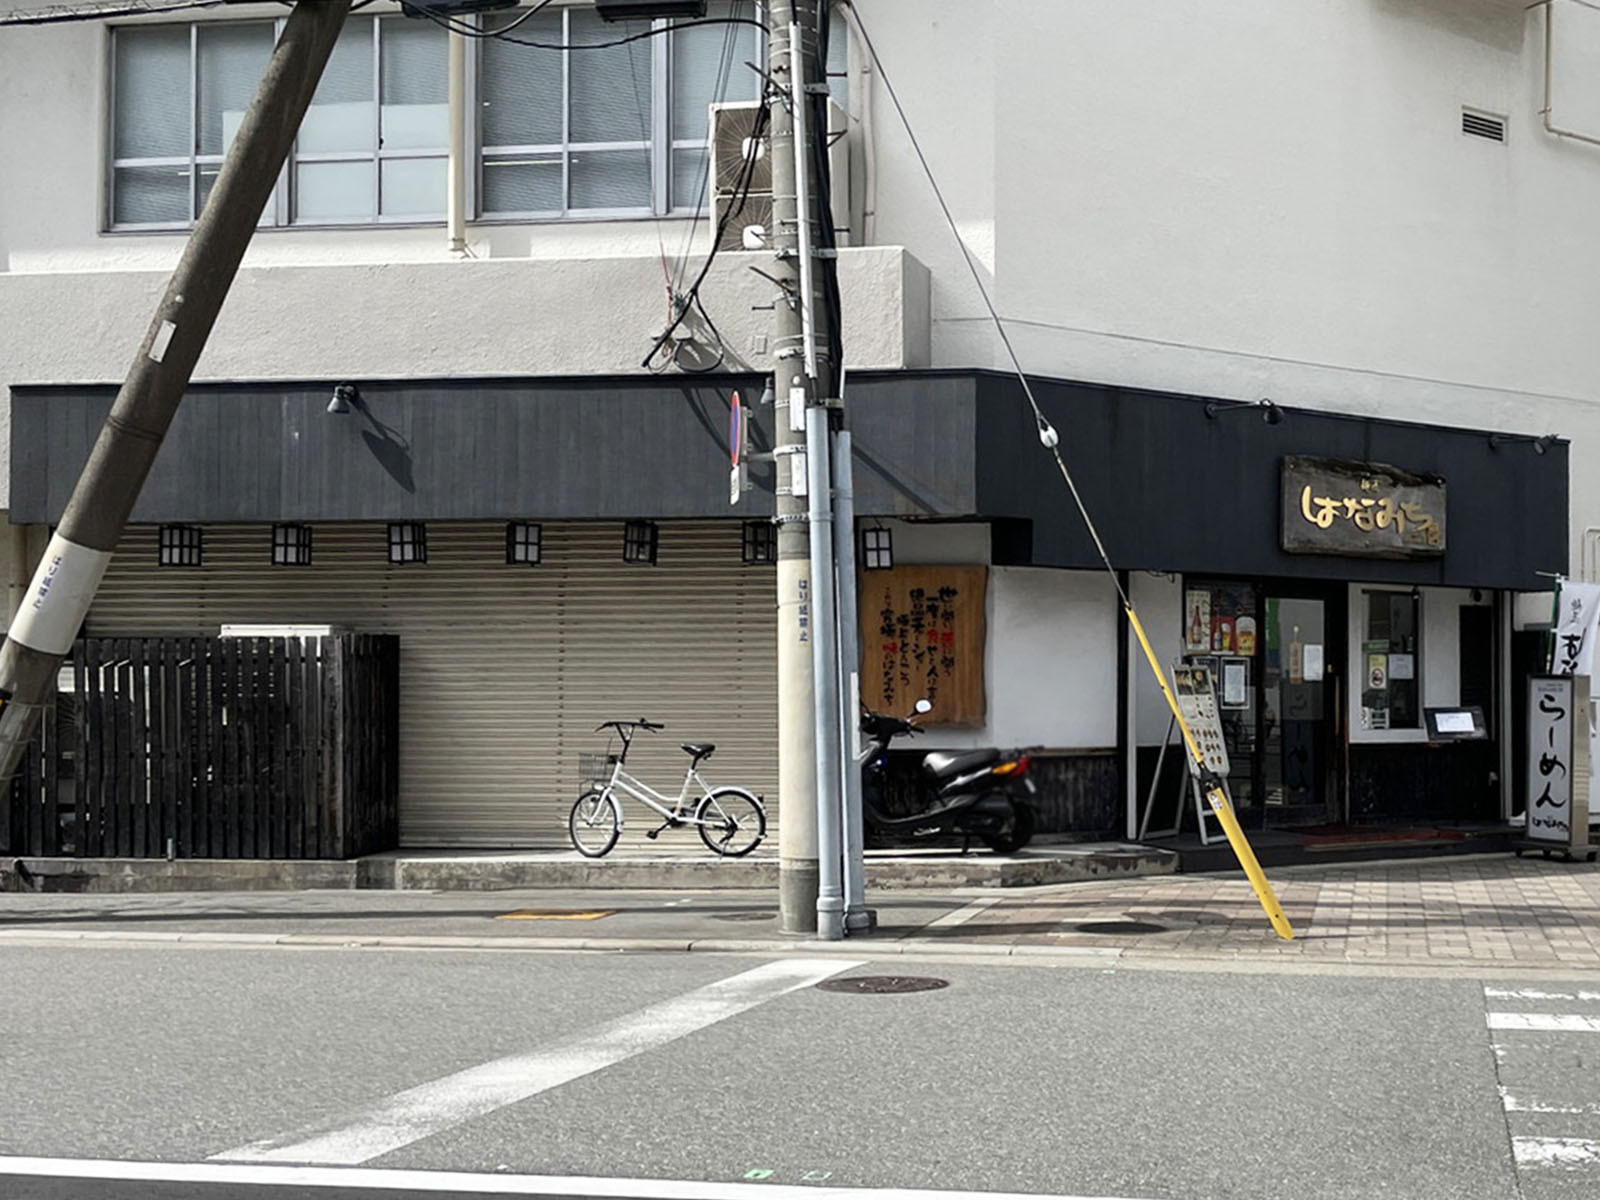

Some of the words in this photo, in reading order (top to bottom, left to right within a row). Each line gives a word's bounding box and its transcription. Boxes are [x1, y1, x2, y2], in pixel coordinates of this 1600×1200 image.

[1301, 485, 1434, 534] はなみち
[1535, 693, 1567, 809] らーめん
